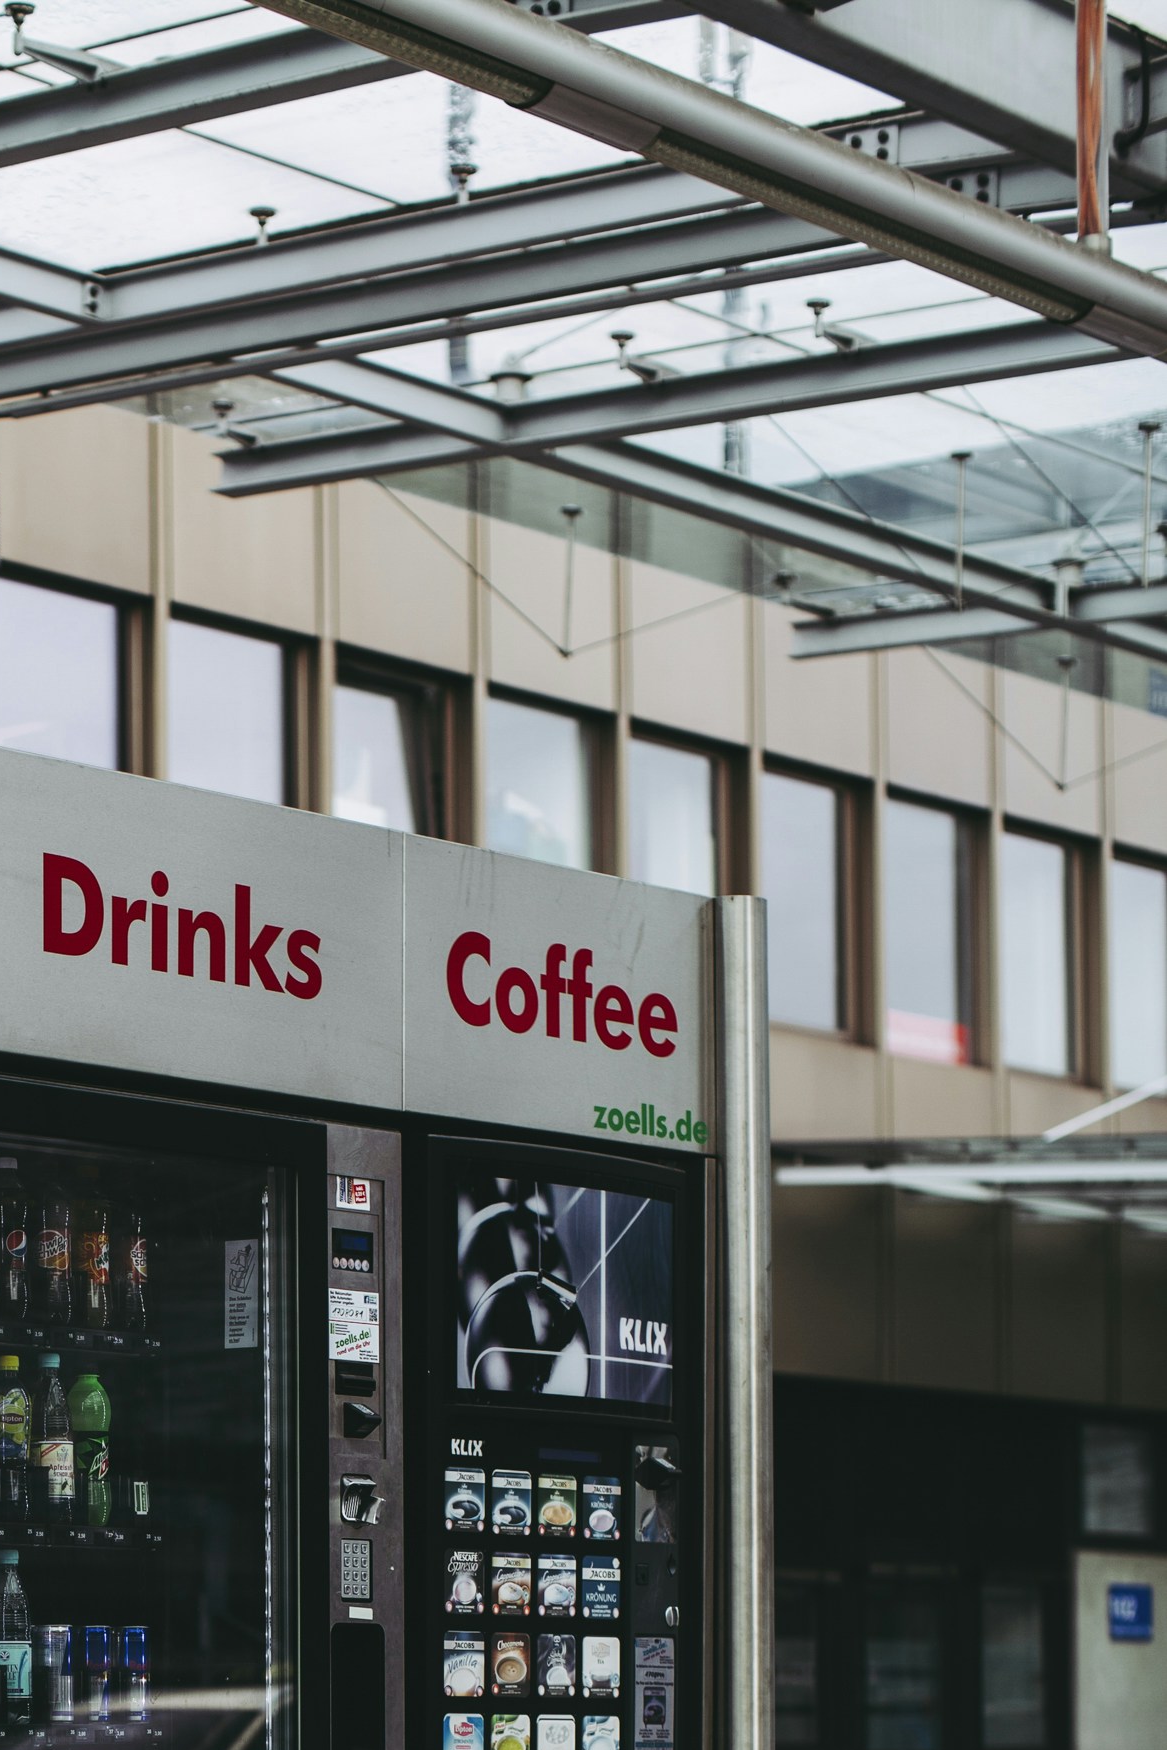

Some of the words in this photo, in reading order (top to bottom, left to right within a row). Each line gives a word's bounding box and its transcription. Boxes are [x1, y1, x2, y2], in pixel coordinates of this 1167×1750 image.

[42, 852, 323, 1001] Drinks
[446, 931, 679, 1058] Coffee
[593, 1102, 707, 1145] zoells.de
[335, 1330, 370, 1348] zoells.de
[619, 1317, 668, 1355] KLIX
[451, 1438, 483, 1457] KLIX
[593, 1486, 613, 1494] JACOBS
[454, 1552, 478, 1562] NESCAFÉ
[590, 1570, 616, 1578] JACOBS
[586, 1592, 617, 1603] KRÖNUNG
[454, 1642, 475, 1650] JACOBS
[448, 1655, 478, 1674] Vanilla
[455, 1724, 473, 1734] Lipton
